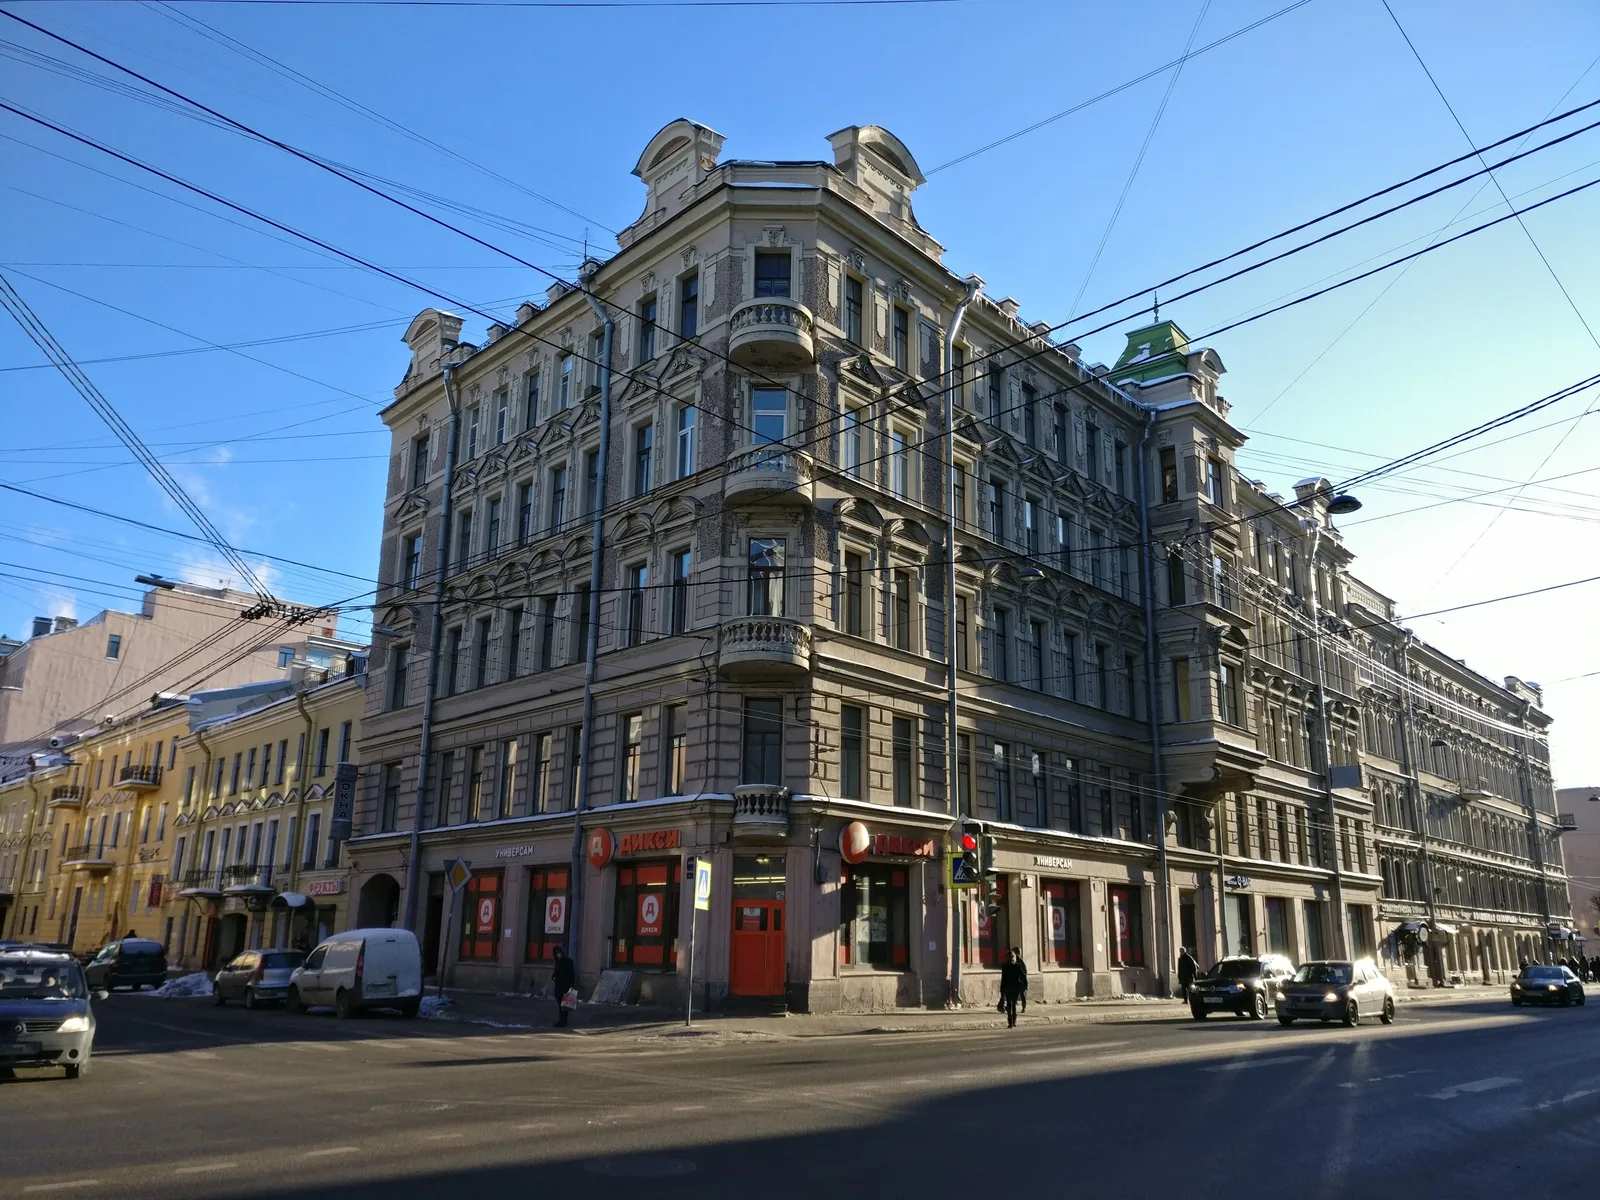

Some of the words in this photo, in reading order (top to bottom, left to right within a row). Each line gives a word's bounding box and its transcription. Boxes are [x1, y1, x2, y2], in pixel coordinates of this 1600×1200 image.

[338, 783, 351, 819] ОКНА
[495, 845, 534, 858] УНИВЕРСАМ
[591, 836, 603, 857] Д
[619, 829, 680, 856] ДИКСИ
[874, 833, 934, 857] ДИКСИ
[1036, 855, 1073, 869] УНИВЕРСАМ
[308, 879, 340, 895] ФРУКТЫ
